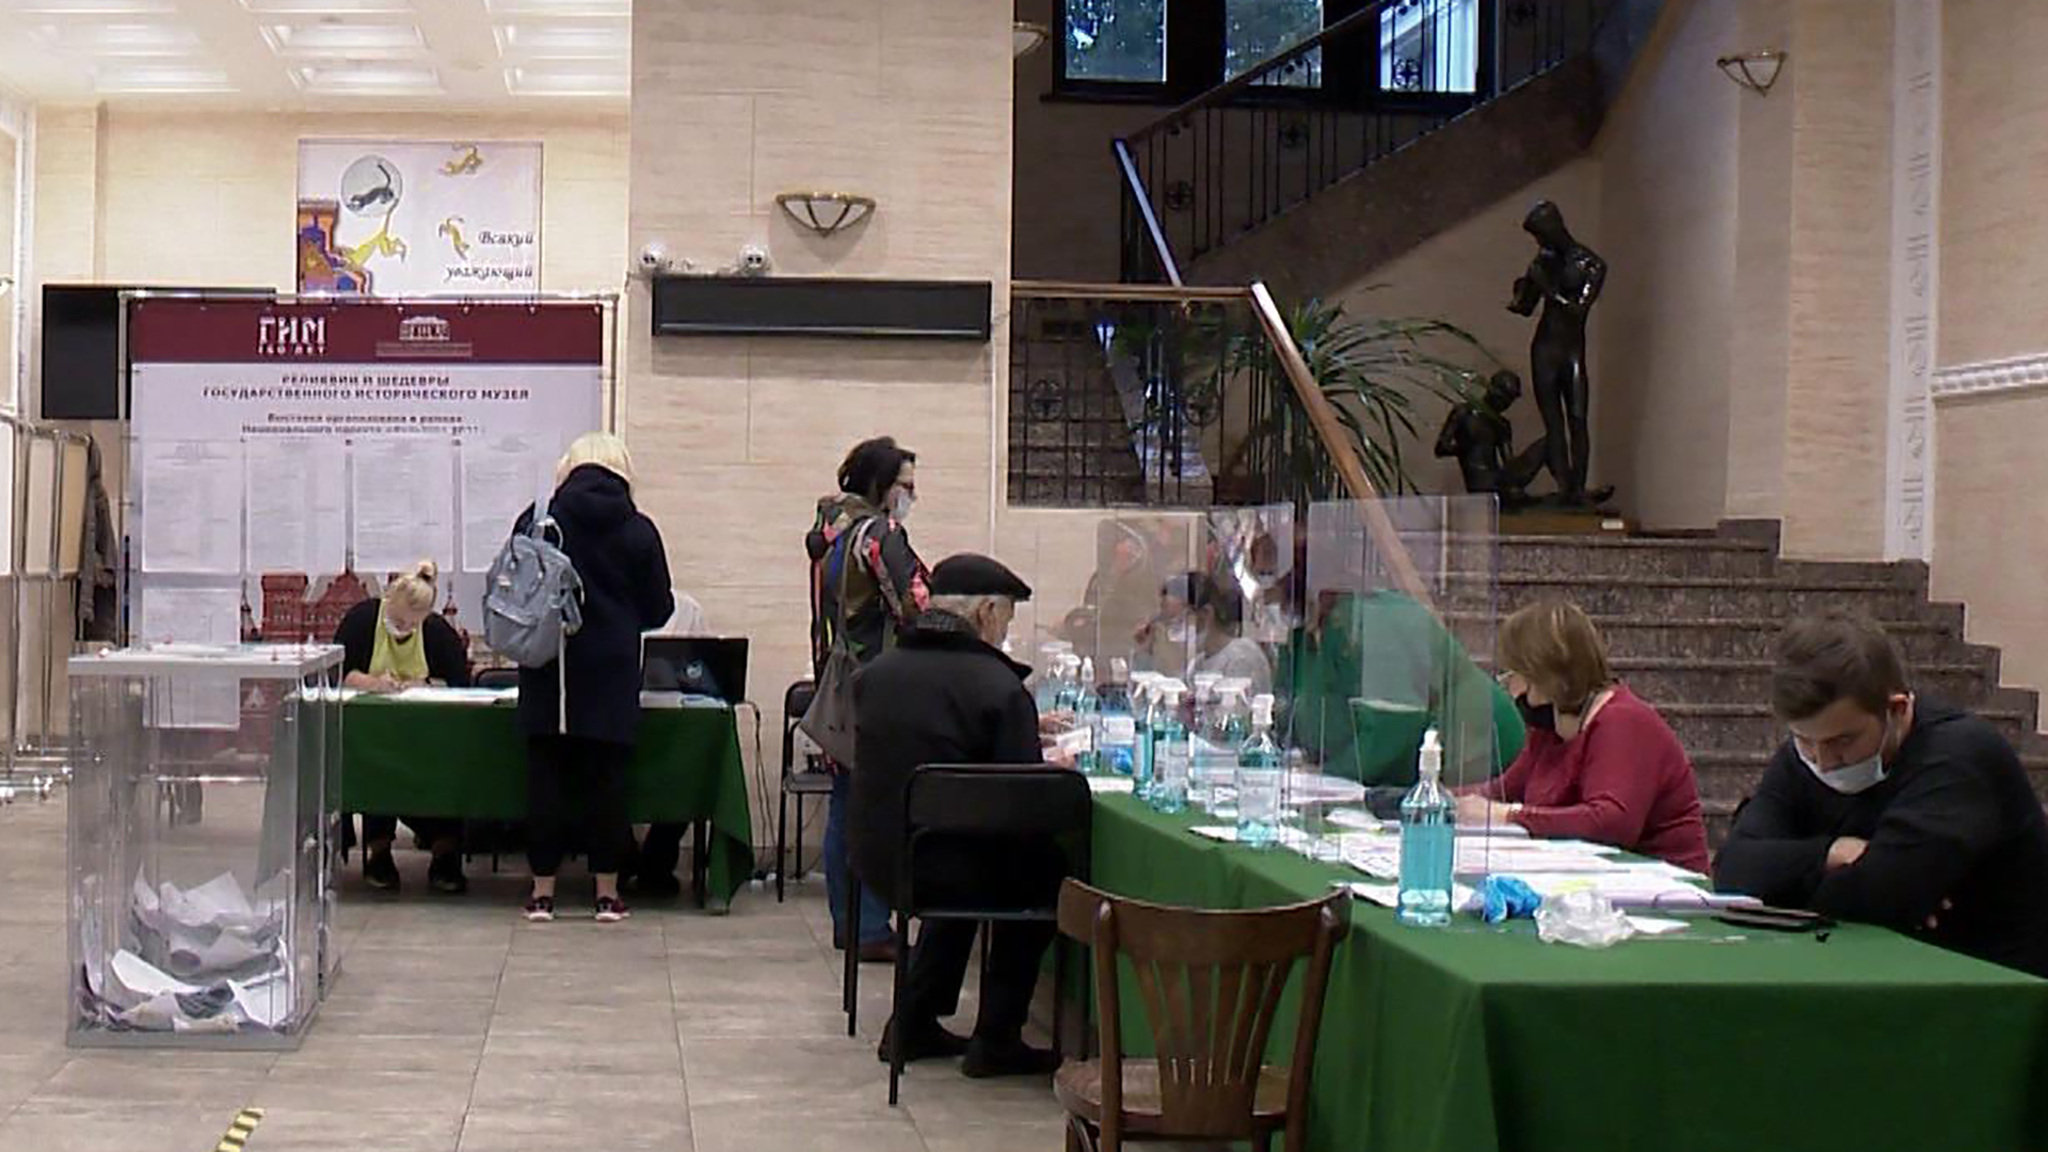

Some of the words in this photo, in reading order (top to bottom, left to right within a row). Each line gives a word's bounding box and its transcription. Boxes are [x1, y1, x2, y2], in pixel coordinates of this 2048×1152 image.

[259, 315, 326, 344] ГИМ
[281, 375, 359, 385] РЕЛИКВИИ
[362, 375, 374, 386] И
[376, 375, 450, 387] ШЕДЕВРЫ
[202, 386, 351, 400] ГОСУДАРСТВЕННОГО
[354, 388, 478, 401] ИСТОРИЧЕСКОГО
[481, 389, 530, 401] МУЗЕЯ
